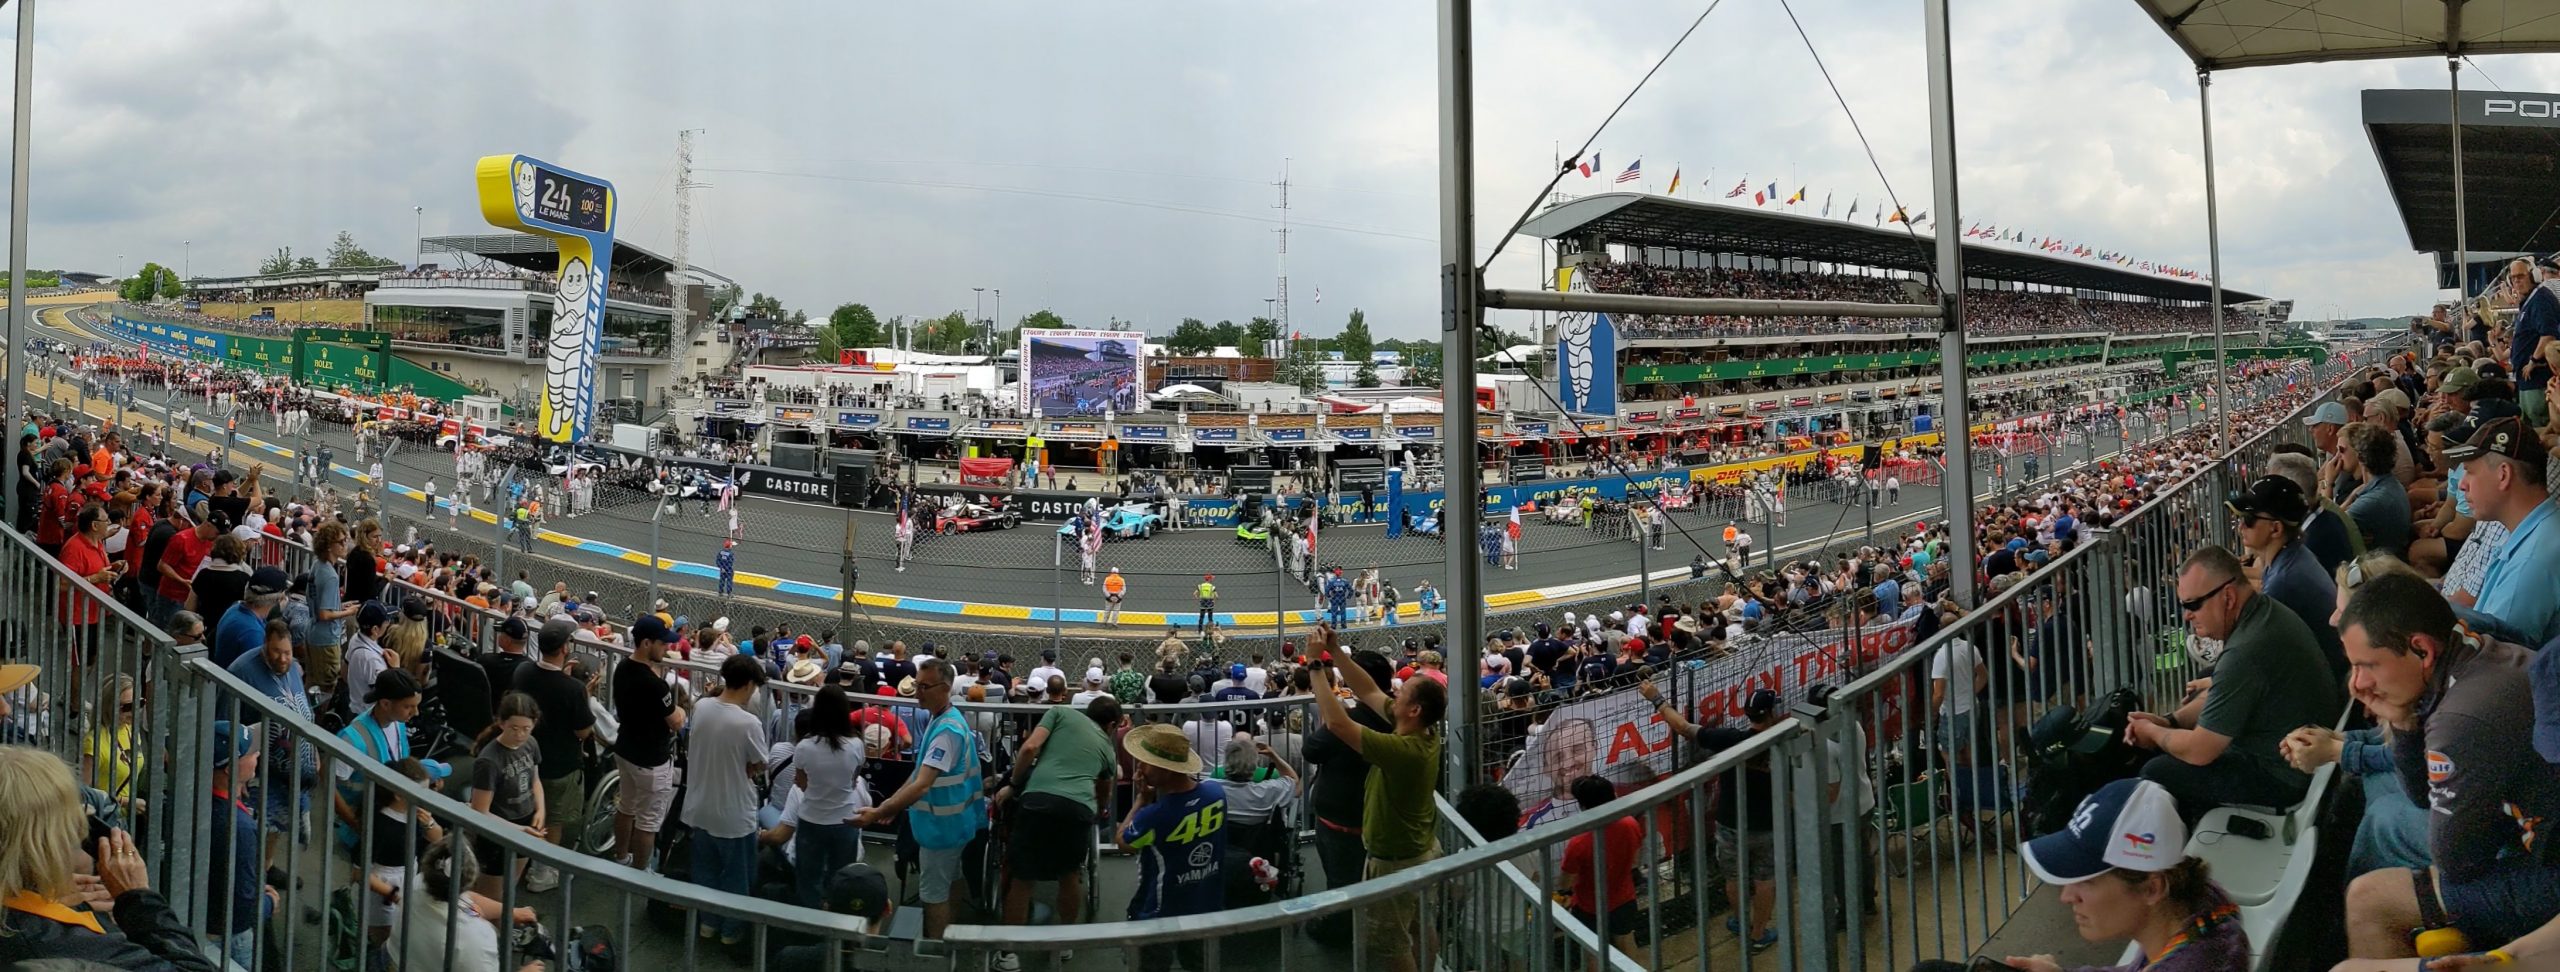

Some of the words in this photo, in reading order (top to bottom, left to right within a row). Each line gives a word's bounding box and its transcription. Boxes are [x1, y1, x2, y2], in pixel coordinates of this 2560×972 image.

[2485, 100, 2560, 118] PO
[540, 178, 571, 212] 24h
[581, 199, 594, 211] 100
[539, 205, 549, 216] LE
[550, 209, 569, 220] MANS
[575, 264, 604, 432] MICHELIN
[255, 352, 269, 361] ROLEX
[282, 355, 294, 364] ROLE
[315, 359, 333, 369] ROLEX
[355, 366, 376, 379] ROLEX
[766, 477, 828, 496] CASTORE
[1031, 501, 1104, 515] CASTOE
[2428, 763, 2451, 772] ulf
[1166, 799, 1224, 844] 46
[1177, 861, 1219, 884] YAMAHA
